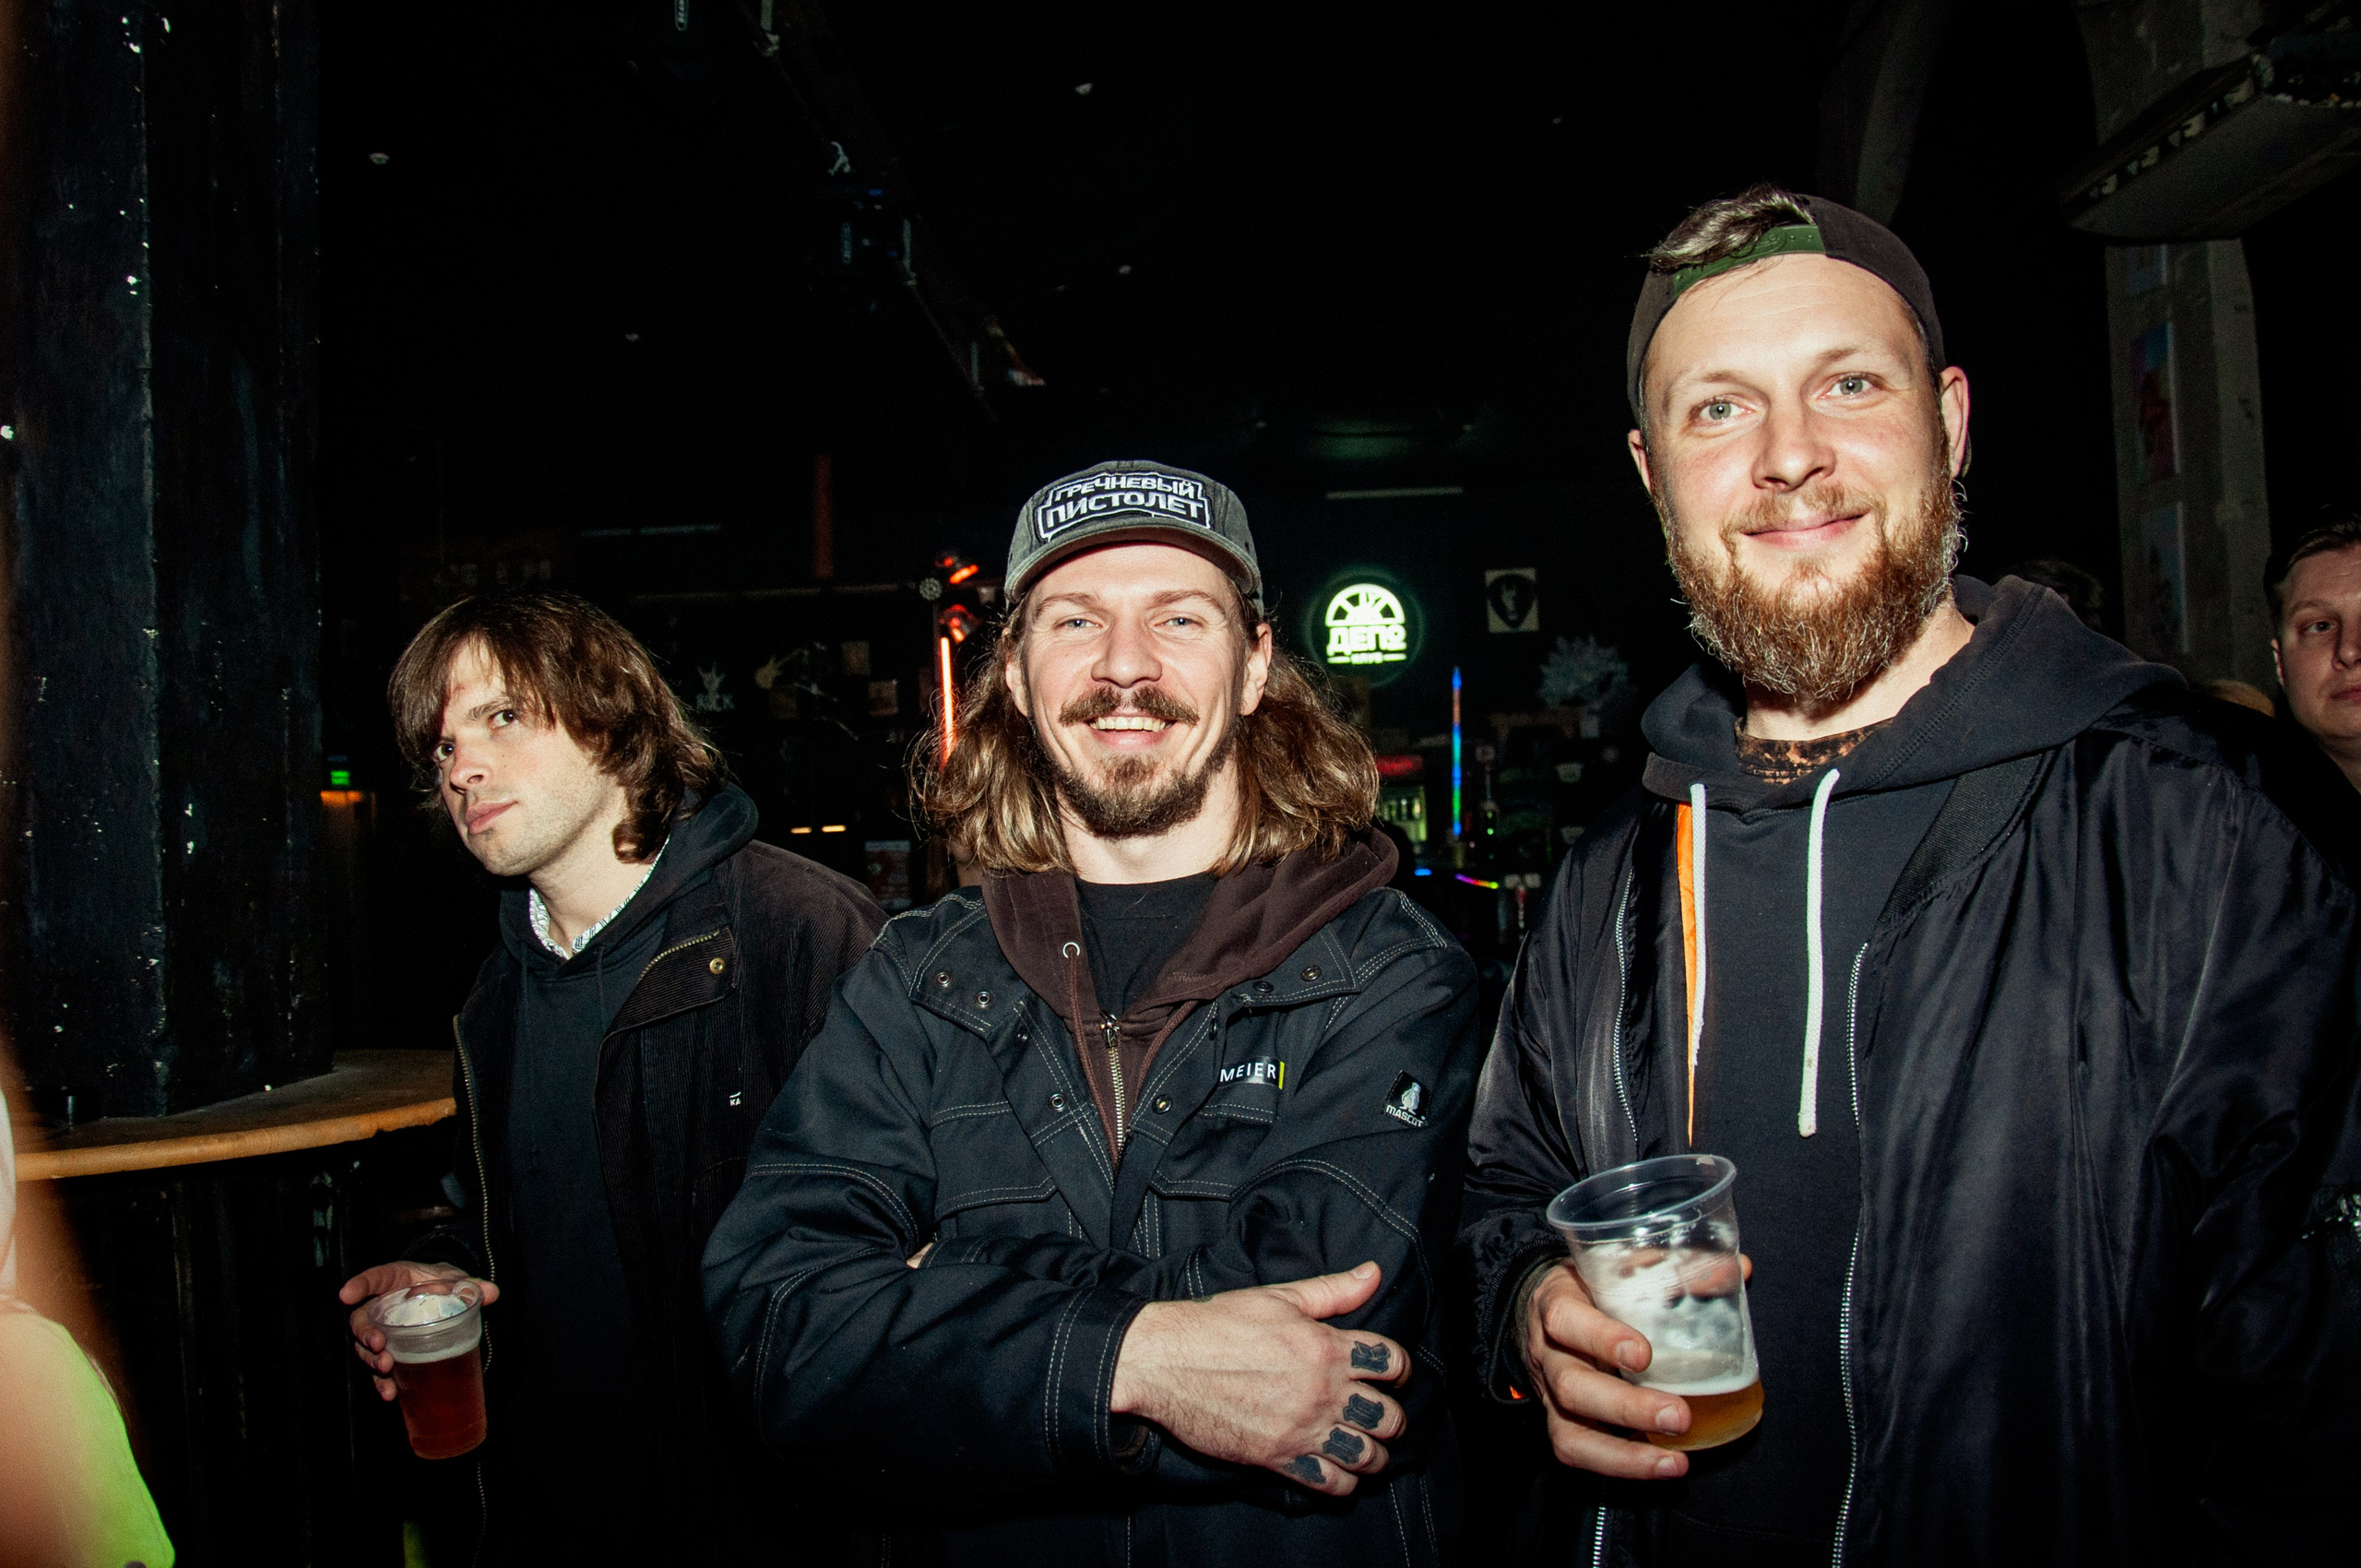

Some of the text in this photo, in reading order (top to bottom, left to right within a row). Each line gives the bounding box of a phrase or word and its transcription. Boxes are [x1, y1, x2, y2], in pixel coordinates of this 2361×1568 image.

[1055, 476, 1195, 501] ГРЕЧНЕВЫЙ
[1046, 491, 1204, 529] ПИСТОЛЕТ
[1326, 624, 1407, 657] ДЕПО
[1219, 1062, 1276, 1083] MEIER
[1385, 1104, 1424, 1127] MASCOT
